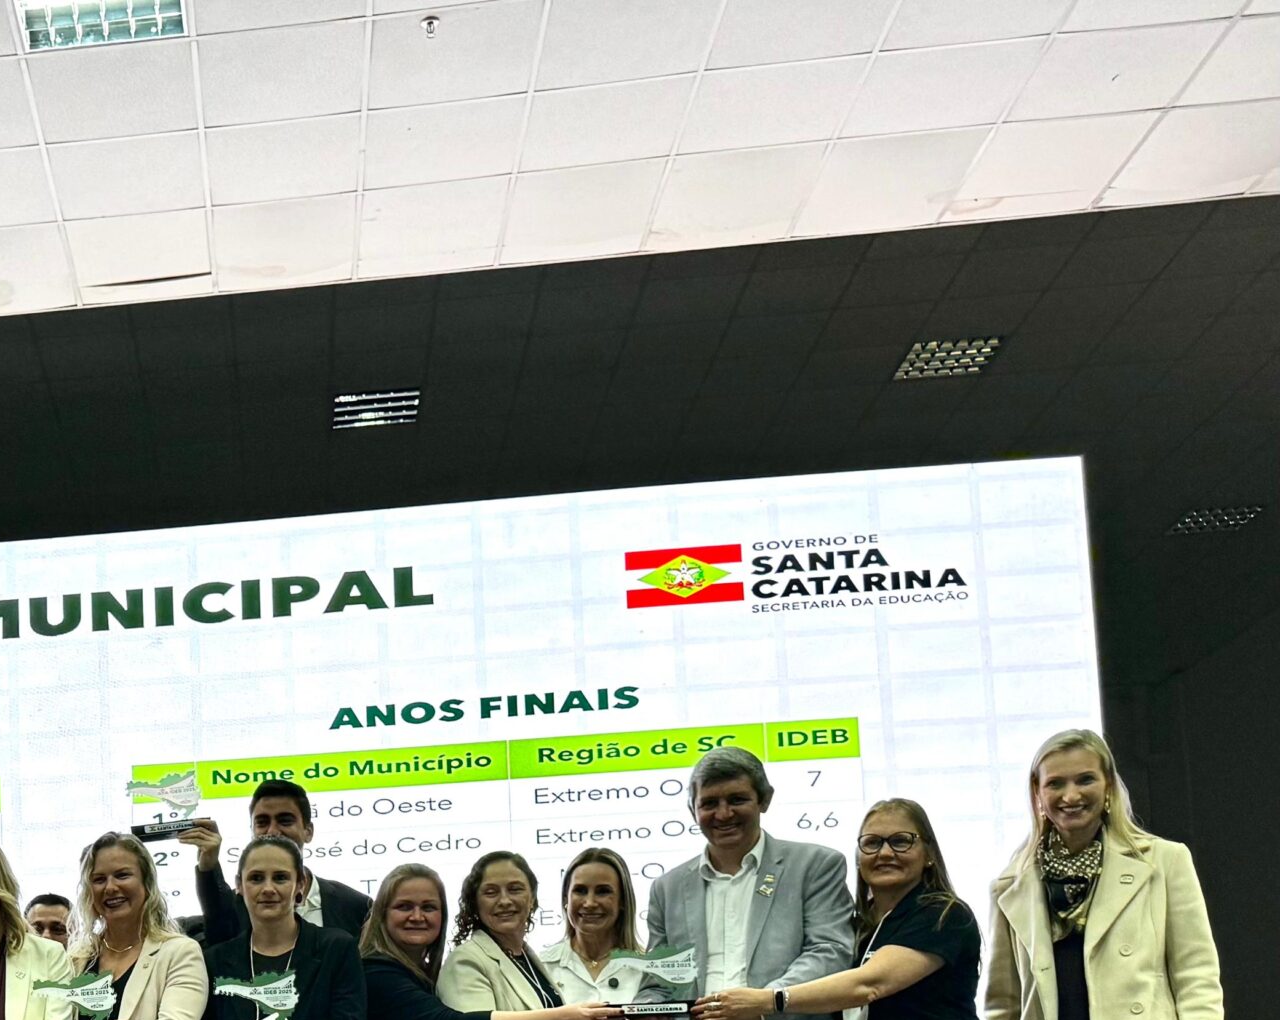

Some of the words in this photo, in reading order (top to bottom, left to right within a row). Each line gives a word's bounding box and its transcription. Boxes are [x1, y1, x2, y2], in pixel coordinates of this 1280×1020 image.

[752, 536, 847, 551] GOVERNO
[854, 534, 878, 544] DE
[751, 548, 889, 575] SANTA
[751, 568, 968, 599] CATARINA
[752, 599, 845, 613] SECRETARIA
[851, 597, 873, 607] DA
[879, 590, 969, 605] EDUCAÇÃO
[329, 699, 464, 730] ANOS
[480, 684, 640, 719] FINAIS
[777, 729, 849, 747] IDEB
[538, 743, 640, 765] Região
[650, 738, 688, 755] de
[697, 735, 736, 752] SC
[212, 769, 295, 785] Nome
[303, 763, 339, 779] do
[349, 752, 492, 773] Município
[807, 771, 822, 787] 7
[534, 787, 649, 805] Extremo
[328, 800, 363, 817] do
[372, 798, 453, 815] Oeste
[797, 812, 839, 831] 6,6
[303, 841, 342, 859] osé
[352, 839, 387, 856] do
[396, 834, 482, 853] Cedro
[536, 828, 652, 845] Extremo
